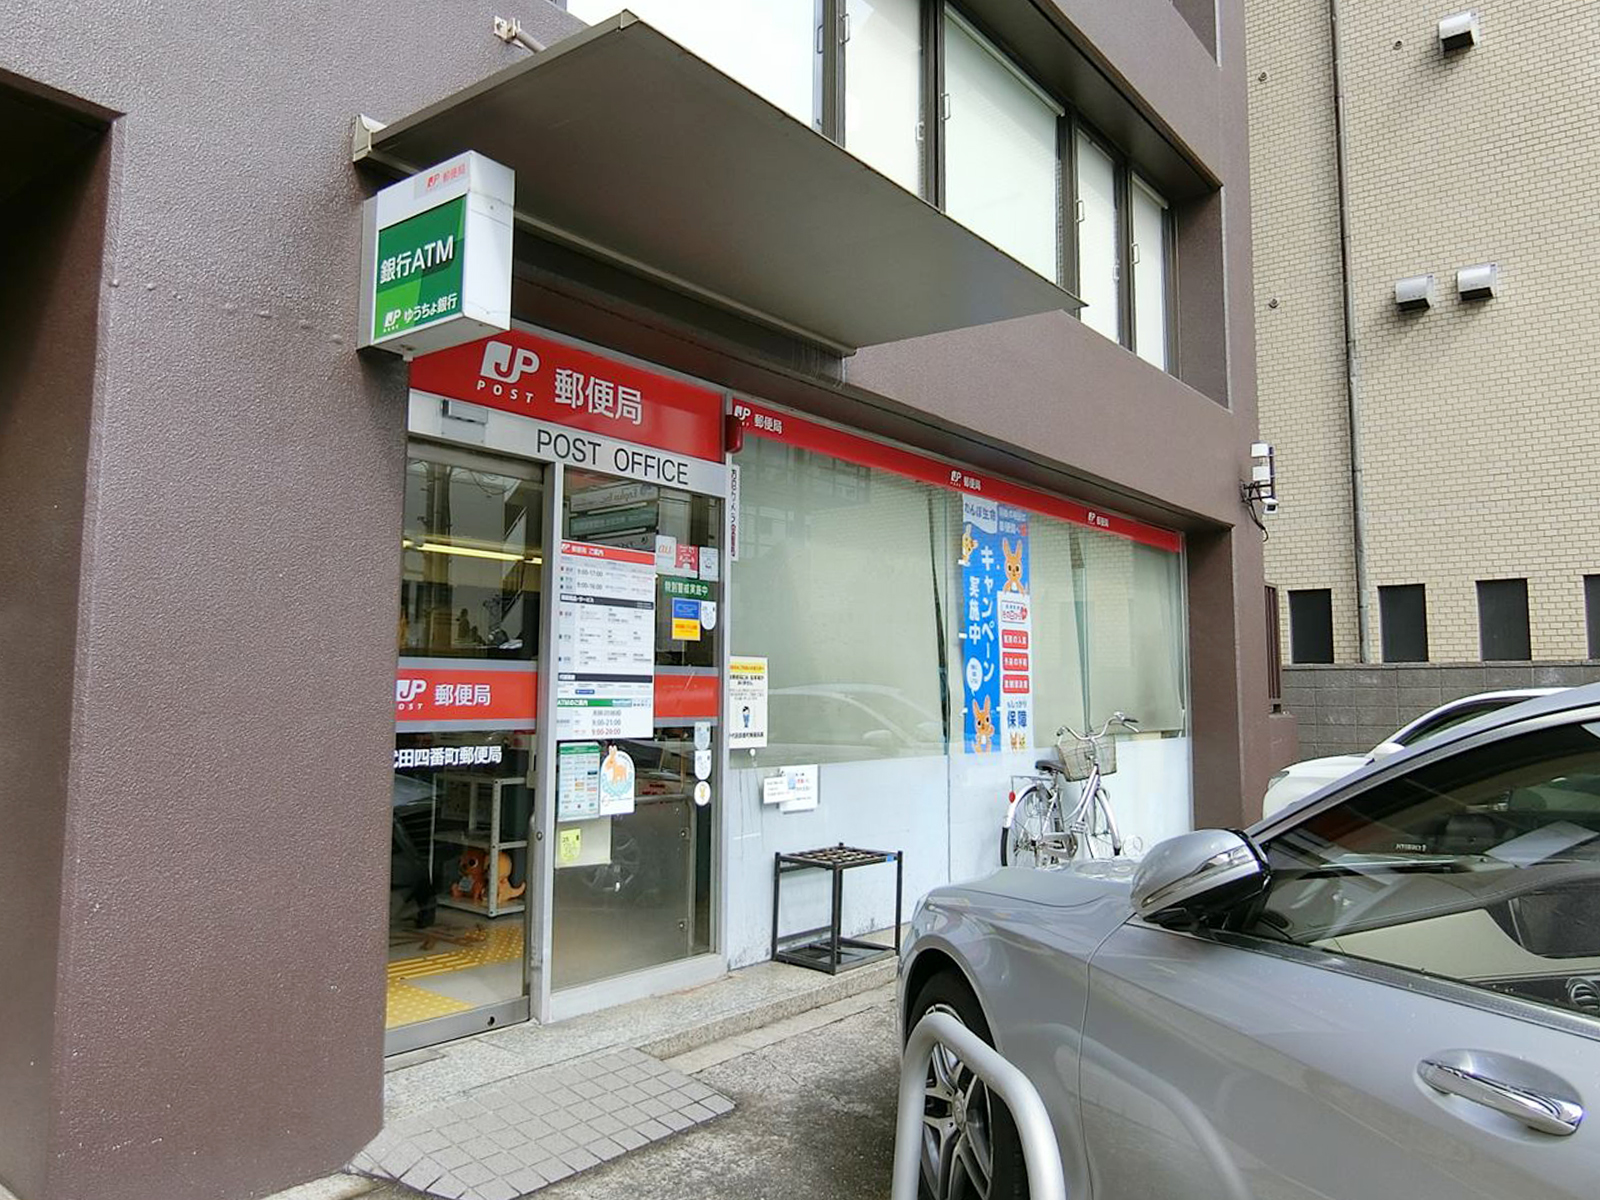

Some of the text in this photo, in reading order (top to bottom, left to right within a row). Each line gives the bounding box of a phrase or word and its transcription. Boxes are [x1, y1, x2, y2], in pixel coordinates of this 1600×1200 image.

[442, 163, 467, 184] 郵便局
[379, 235, 455, 284] 銀行ATM
[403, 293, 458, 323] ゆうちょ銀行
[476, 380, 534, 404] POST
[480, 341, 643, 425] JP 郵便局
[754, 413, 783, 434] 郵便局
[537, 428, 689, 486] POST OFFICE
[963, 475, 982, 491] 郵便局
[1096, 515, 1110, 528] 郵便局
[968, 575, 982, 646] 実施中
[980, 545, 996, 683] キャンペーン
[434, 684, 491, 706] 郵便局
[1006, 710, 1027, 728] 保障
